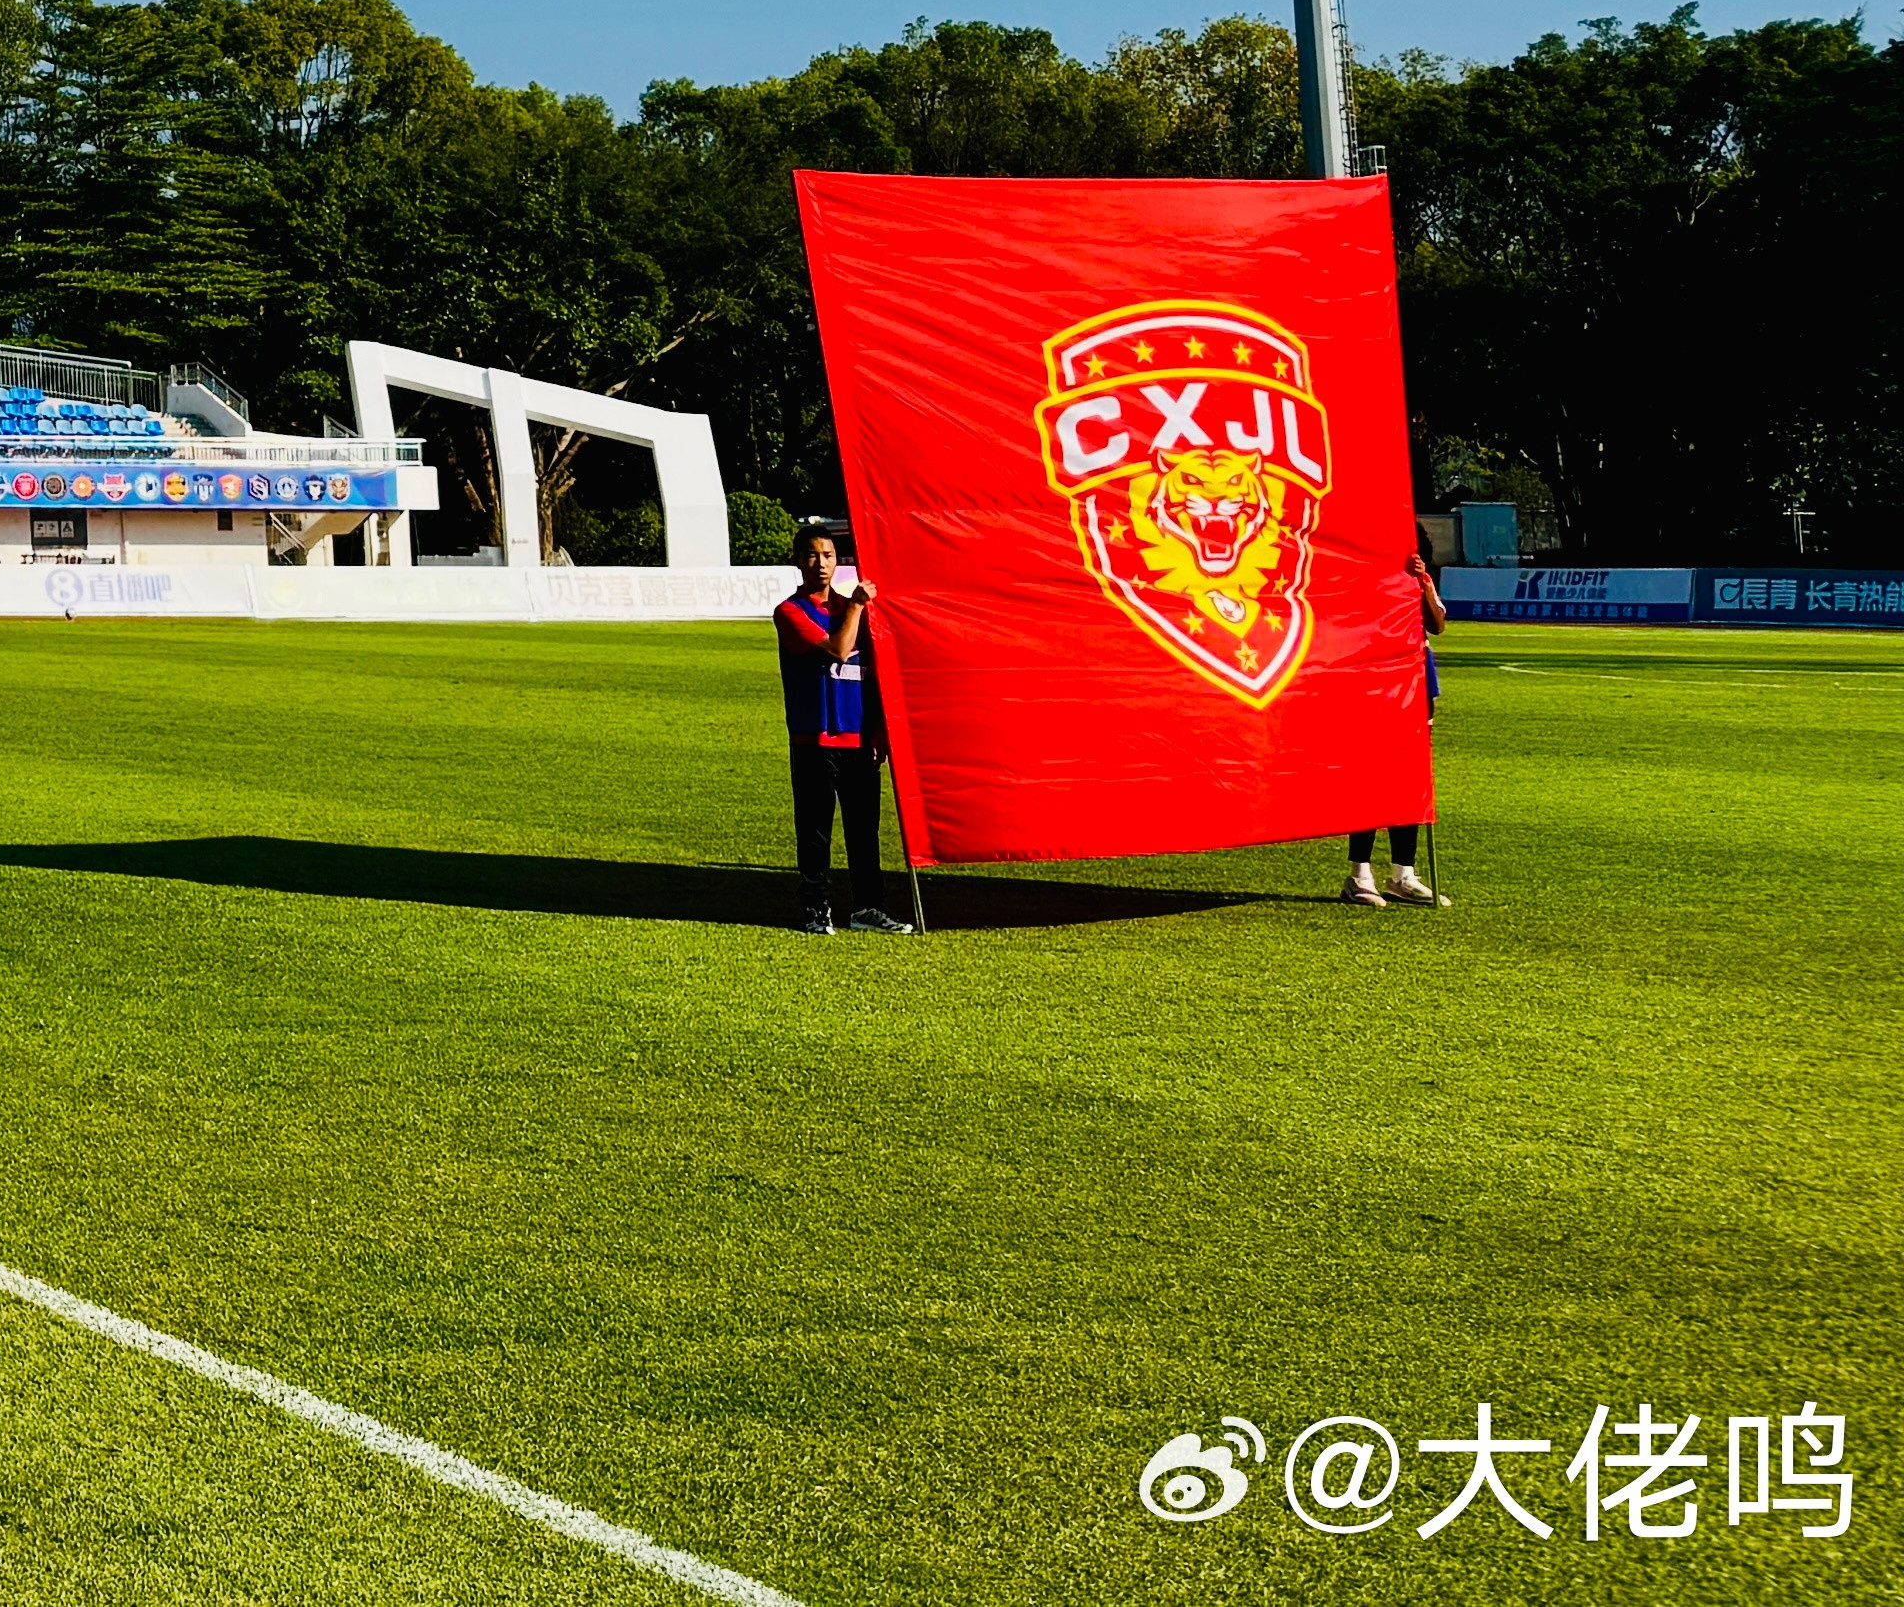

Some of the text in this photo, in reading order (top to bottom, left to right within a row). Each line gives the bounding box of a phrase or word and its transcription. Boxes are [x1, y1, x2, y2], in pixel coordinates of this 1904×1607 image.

[1055, 382, 1324, 484] CXJL
[546, 574, 634, 608] 贝克营
[1547, 570, 1611, 586] IKIDFIT
